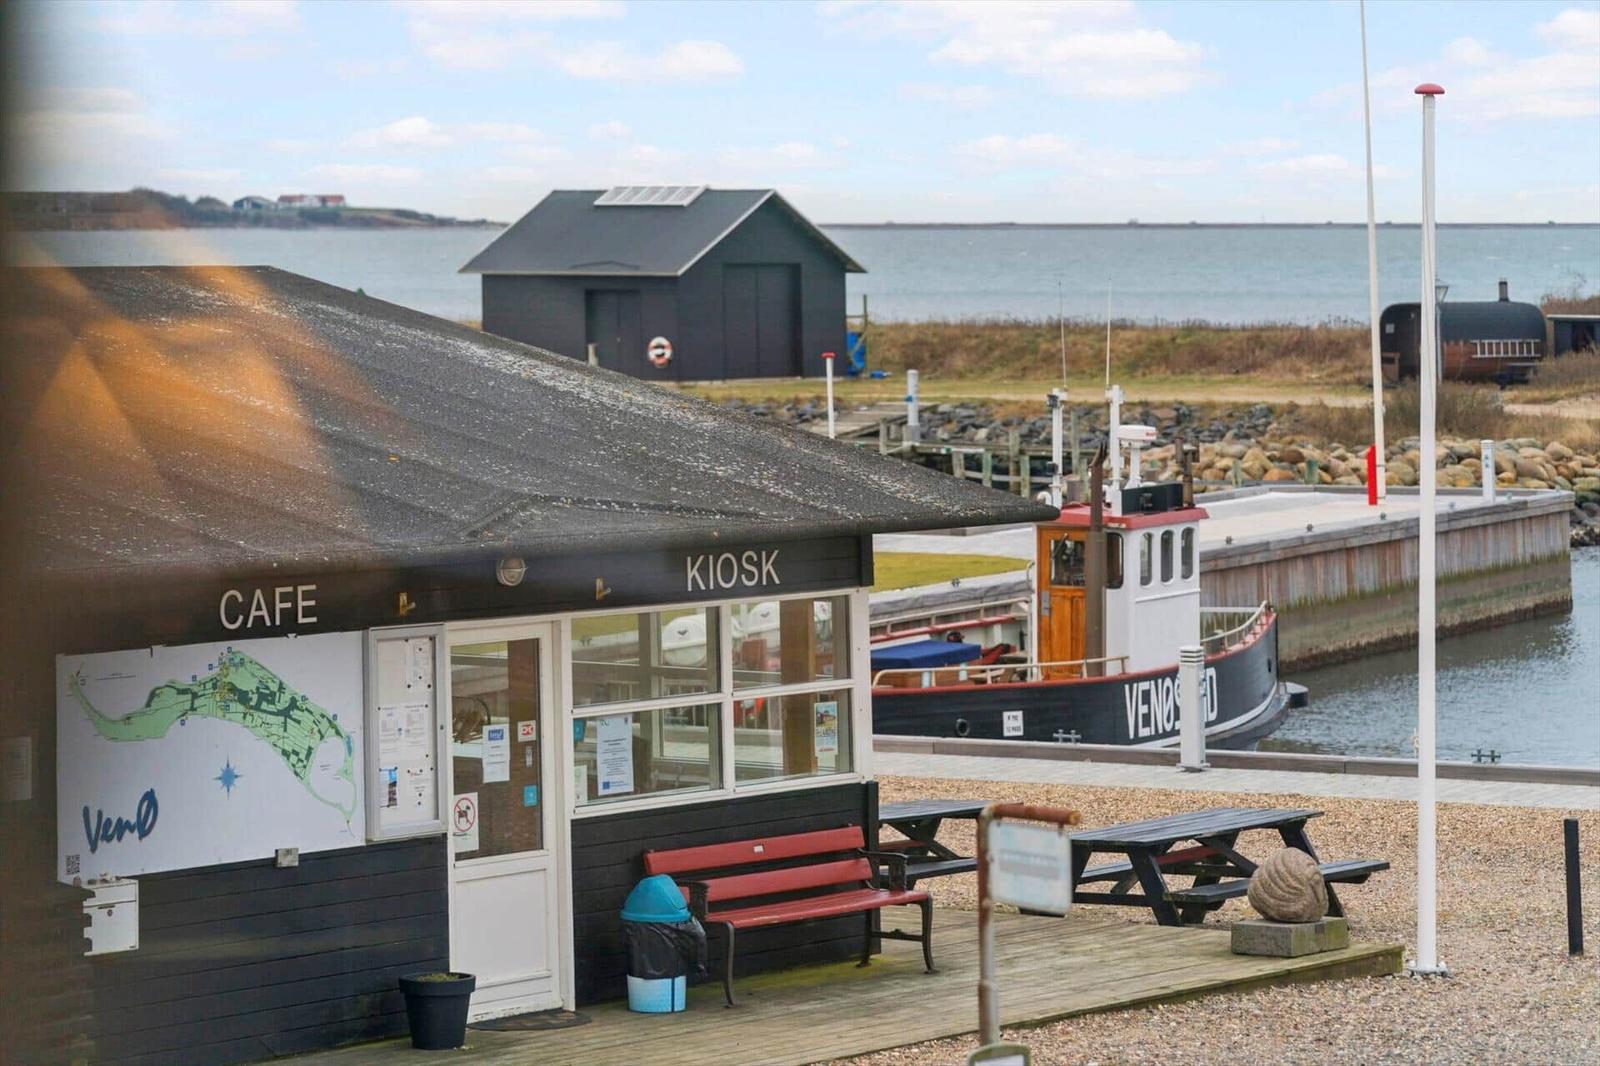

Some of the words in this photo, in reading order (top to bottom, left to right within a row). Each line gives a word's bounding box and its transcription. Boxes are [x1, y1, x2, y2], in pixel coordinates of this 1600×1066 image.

[687, 549, 780, 592] KIOSK
[220, 584, 317, 630] CAFE
[1124, 667, 1218, 739] VENØD
